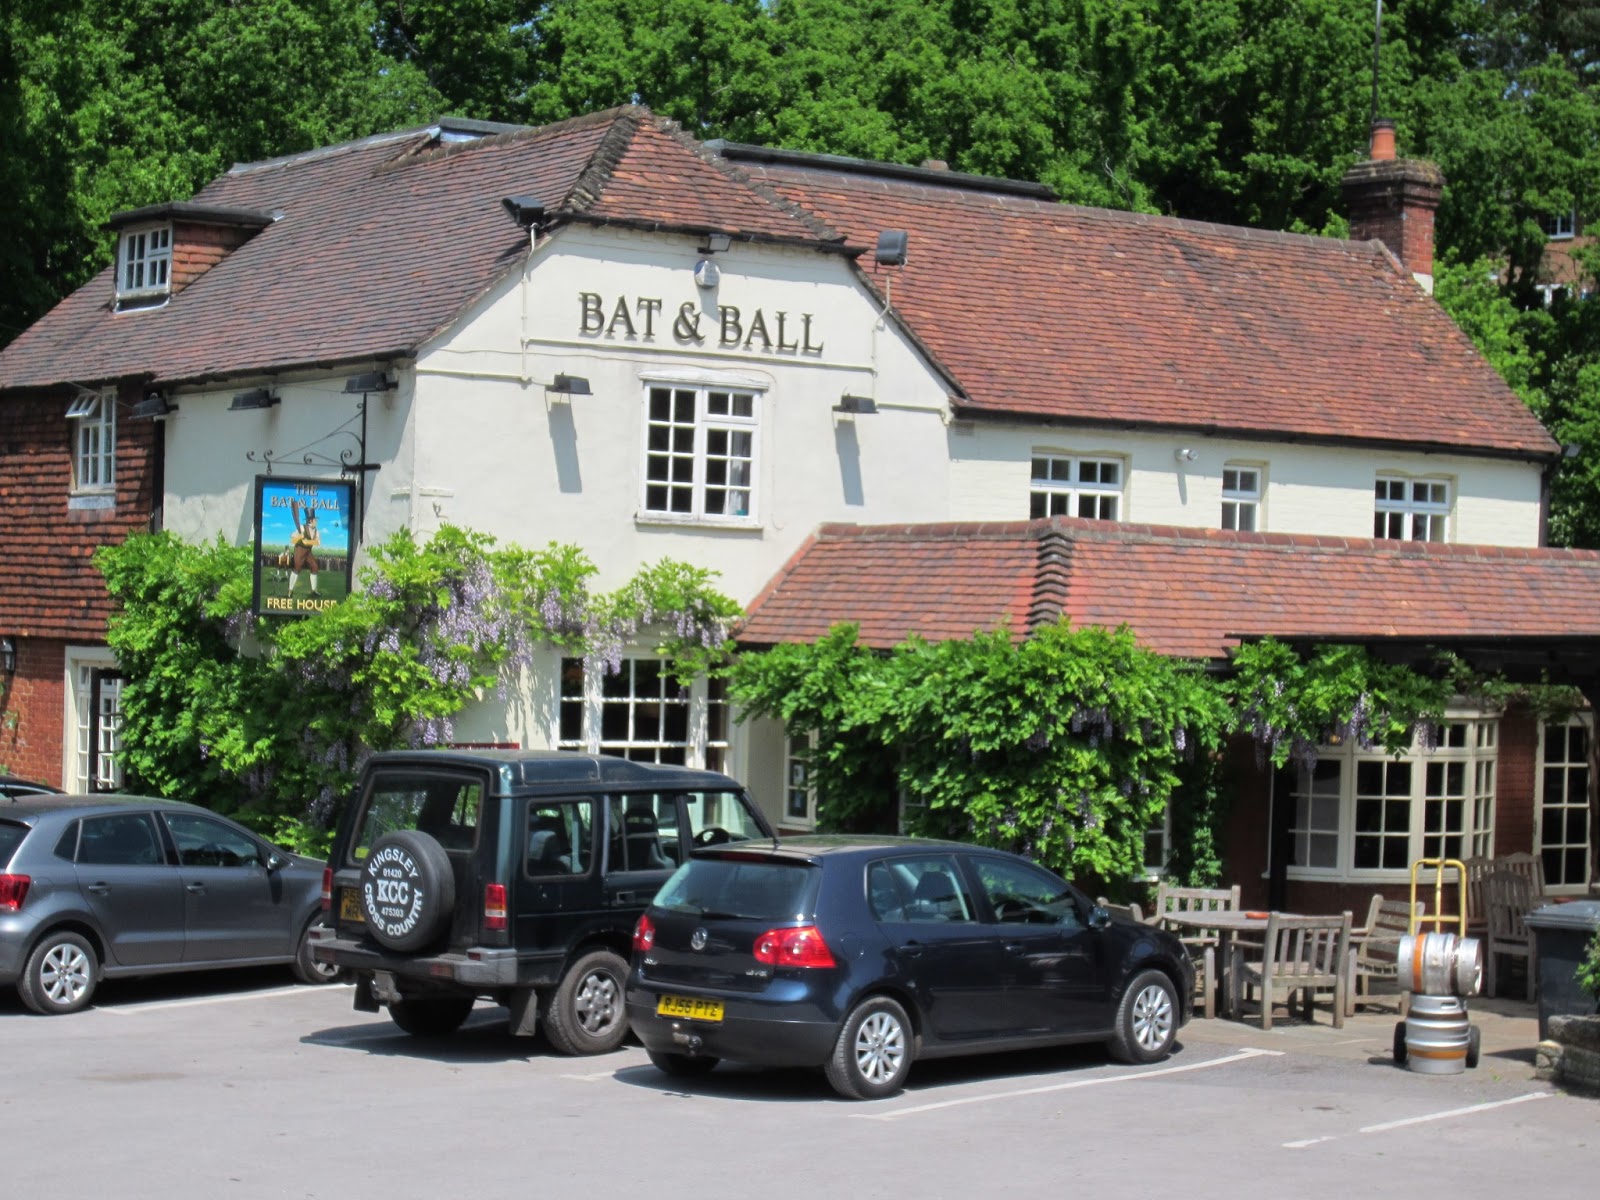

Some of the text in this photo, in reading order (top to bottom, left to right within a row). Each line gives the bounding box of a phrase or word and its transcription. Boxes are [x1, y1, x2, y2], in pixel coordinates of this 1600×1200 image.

[579, 291, 824, 352] BAT & BALL
[294, 484, 318, 496] THE
[271, 496, 295, 508] BAT
[311, 498, 340, 510] BALL
[267, 598, 293, 609] FREE
[368, 848, 418, 878] KINGSLEY
[383, 868, 402, 878] 01420
[376, 879, 409, 905] KCC
[364, 883, 423, 936] CROSS COUNTRY
[381, 906, 404, 918] 475303
